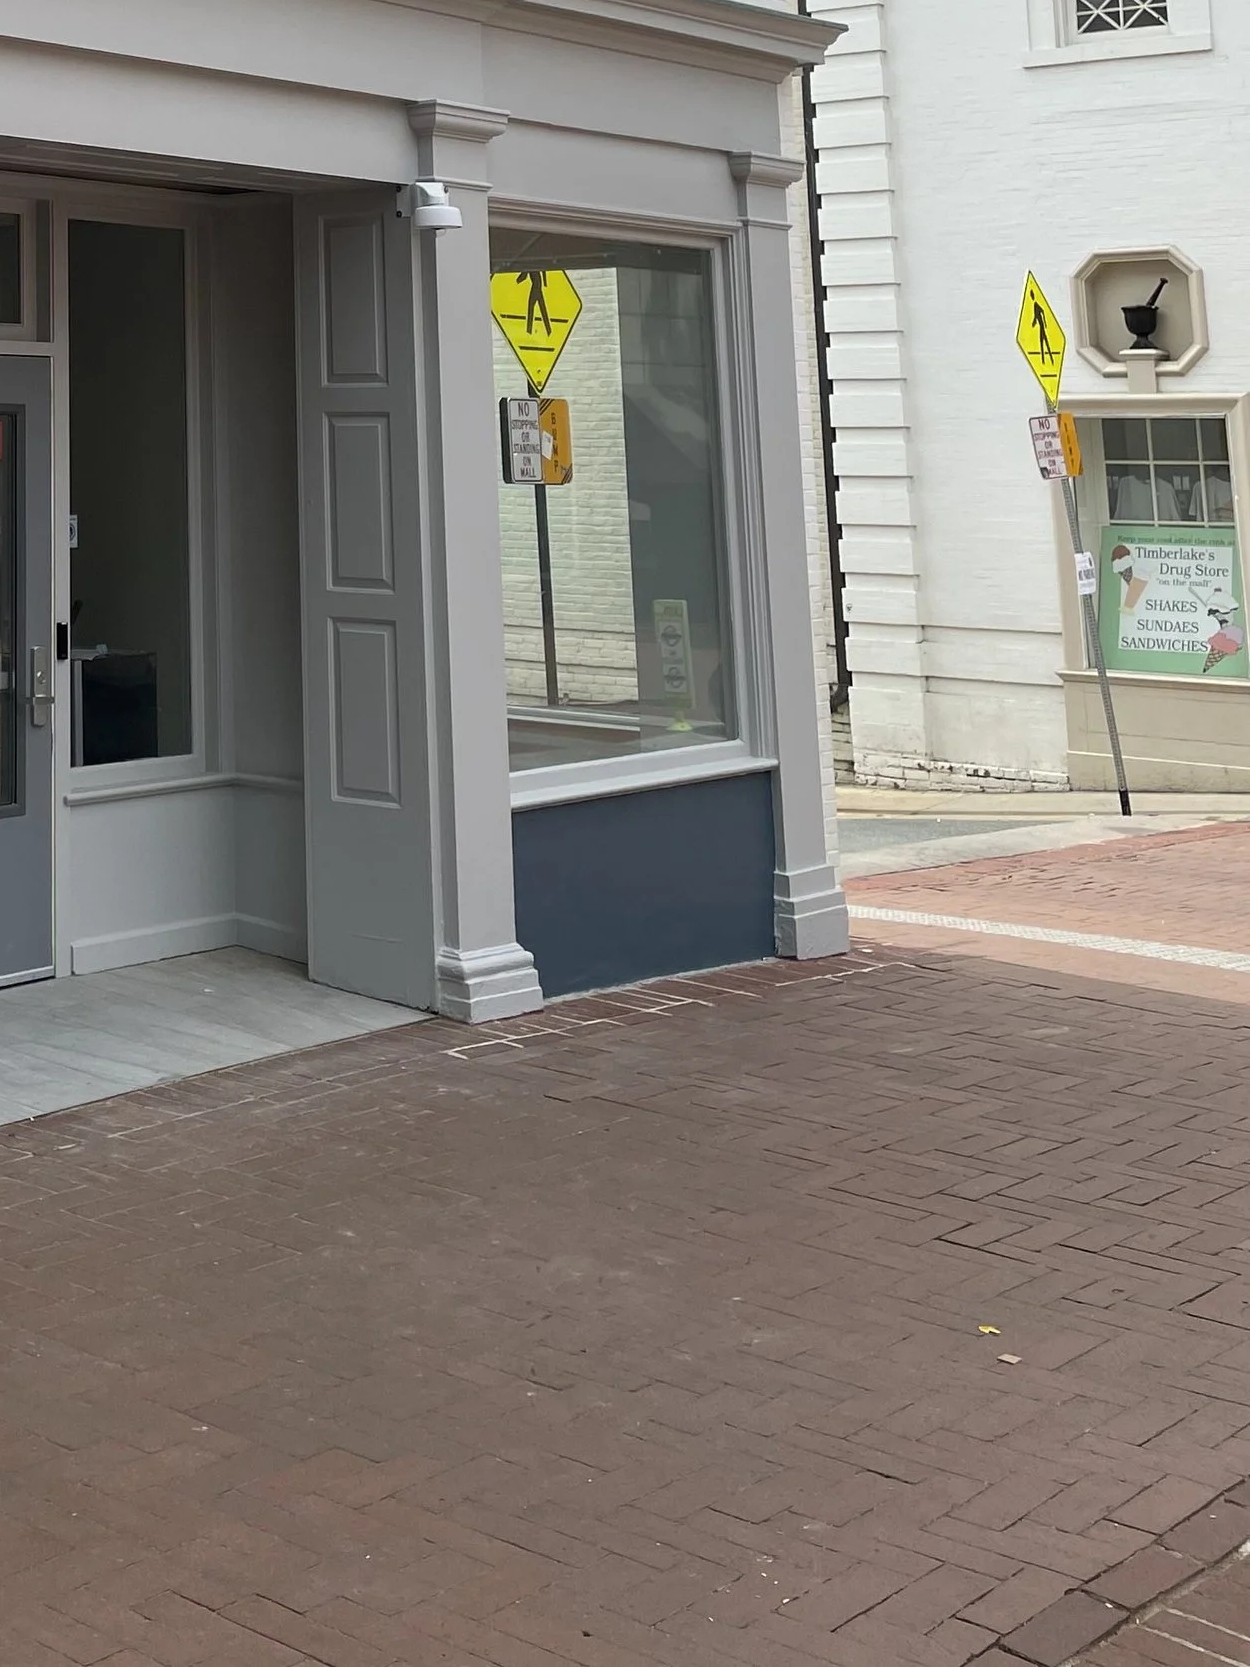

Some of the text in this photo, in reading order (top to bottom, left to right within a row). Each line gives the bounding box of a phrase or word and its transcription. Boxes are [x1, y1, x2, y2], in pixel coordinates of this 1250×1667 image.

[518, 402, 530, 417] NO
[511, 420, 539, 430] STOPPING
[1038, 418, 1051, 430] NO
[521, 432, 530, 442] OR
[513, 443, 540, 453] STANDING
[522, 456, 532, 466] ON
[520, 467, 537, 478] MALL
[1135, 546, 1216, 561] Timberlake's
[1159, 563, 1230, 579] Drug Store
[1172, 577, 1187, 587] the
[1145, 598, 1198, 613] SHAKES
[1137, 619, 1200, 633] SUNDAES
[1121, 636, 1209, 652] SANDWICHES
